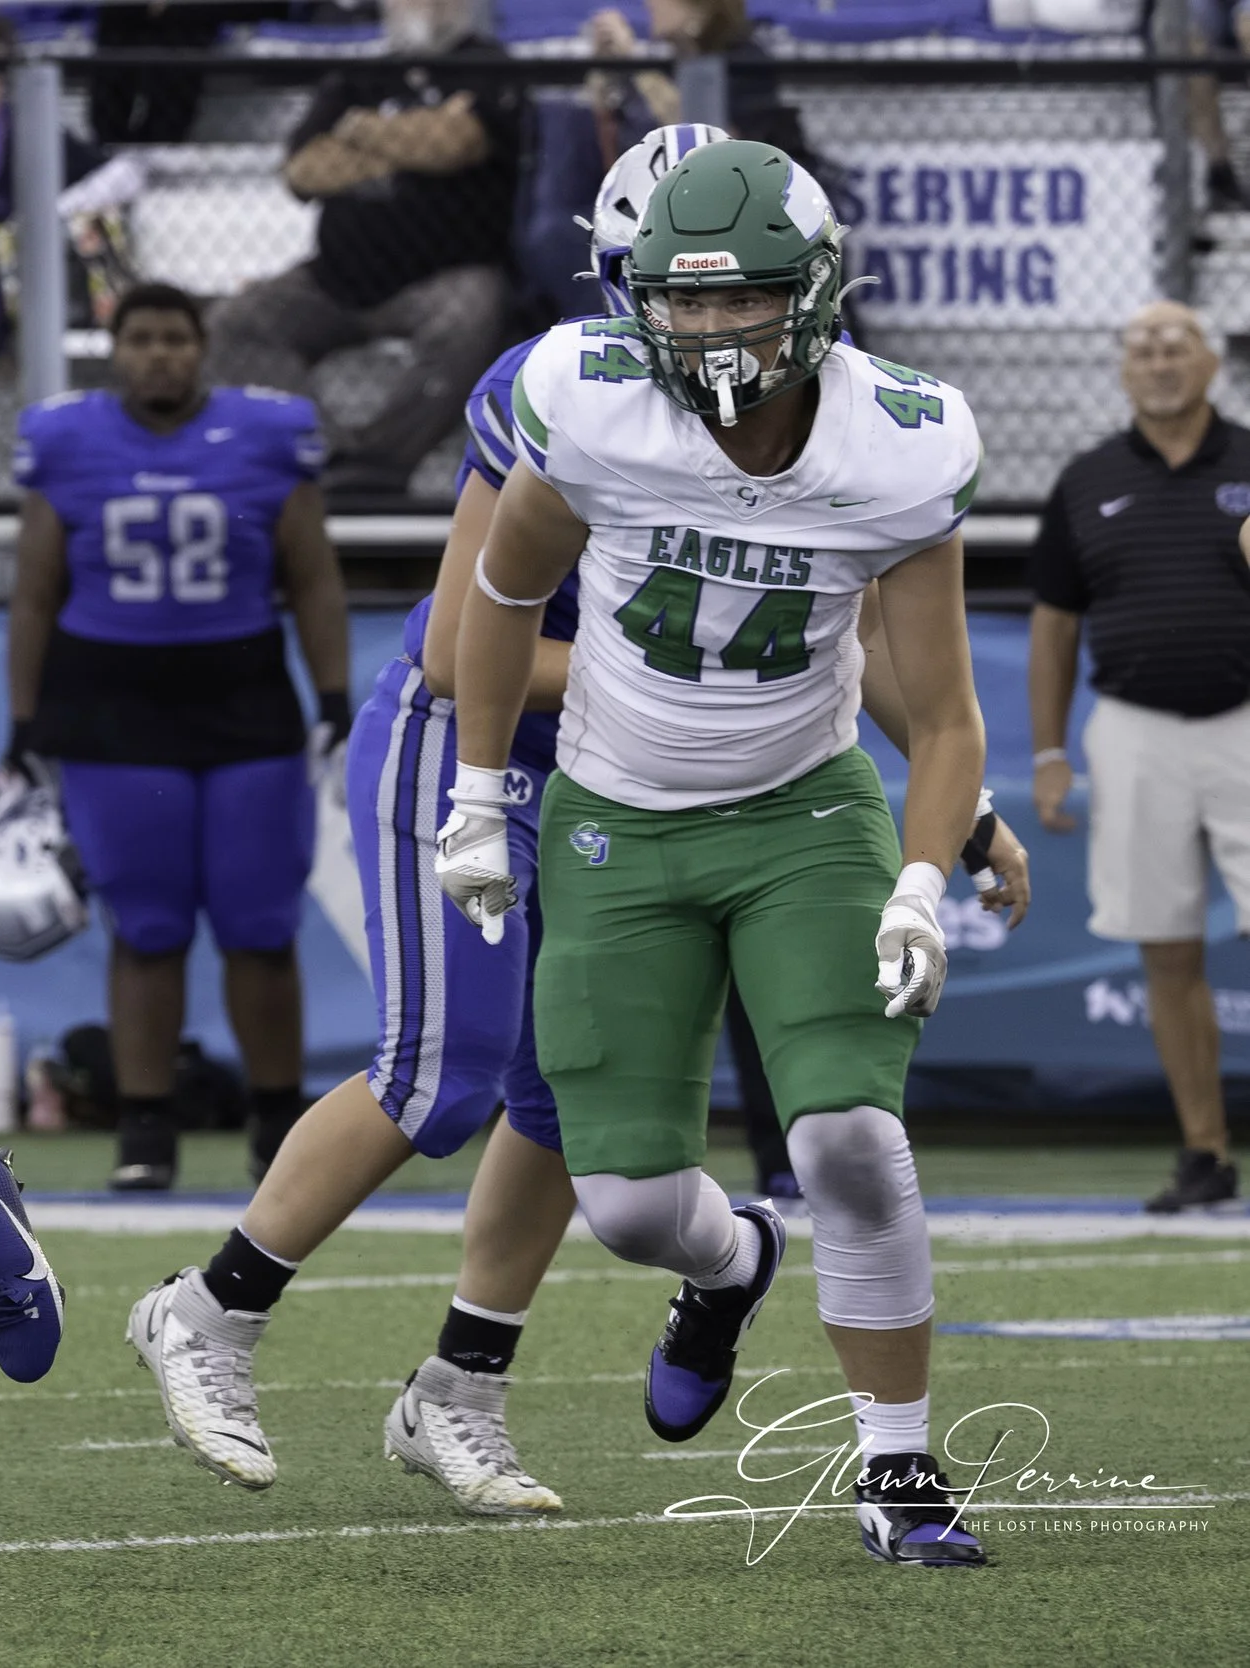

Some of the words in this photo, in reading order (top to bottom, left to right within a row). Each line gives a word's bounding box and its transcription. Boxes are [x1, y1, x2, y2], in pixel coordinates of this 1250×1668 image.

[677, 256, 729, 270] Riddell
[102, 491, 229, 604] 58
[647, 526, 816, 588] EAGLES
[612, 565, 817, 684] 44
